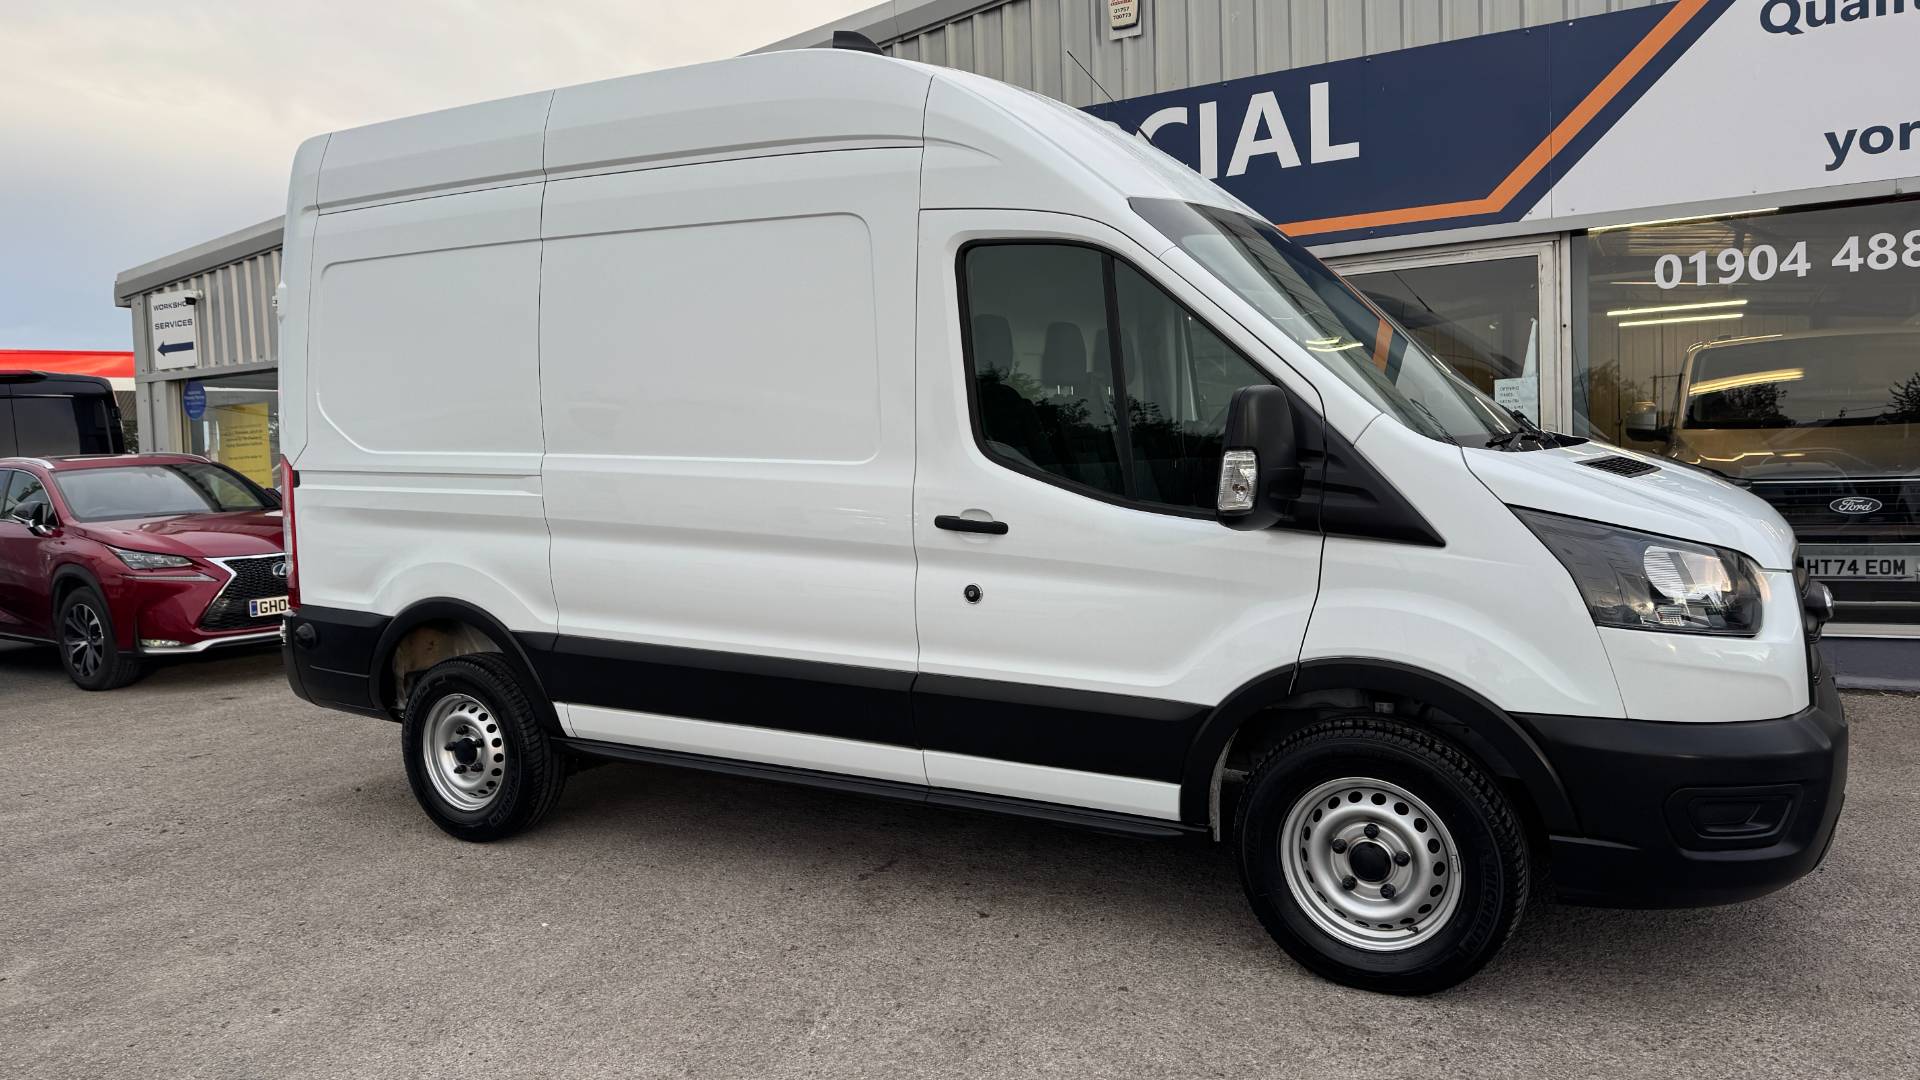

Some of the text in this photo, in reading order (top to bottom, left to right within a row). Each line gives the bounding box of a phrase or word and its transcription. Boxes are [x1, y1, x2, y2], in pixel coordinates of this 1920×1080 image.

[1654, 229, 1920, 290] 01904 488
[153, 300, 188, 311] WORKSHO
[154, 318, 193, 330] SERVICES
[1838, 498, 1873, 512] Ford
[1807, 559, 1906, 575] HT74 EOM
